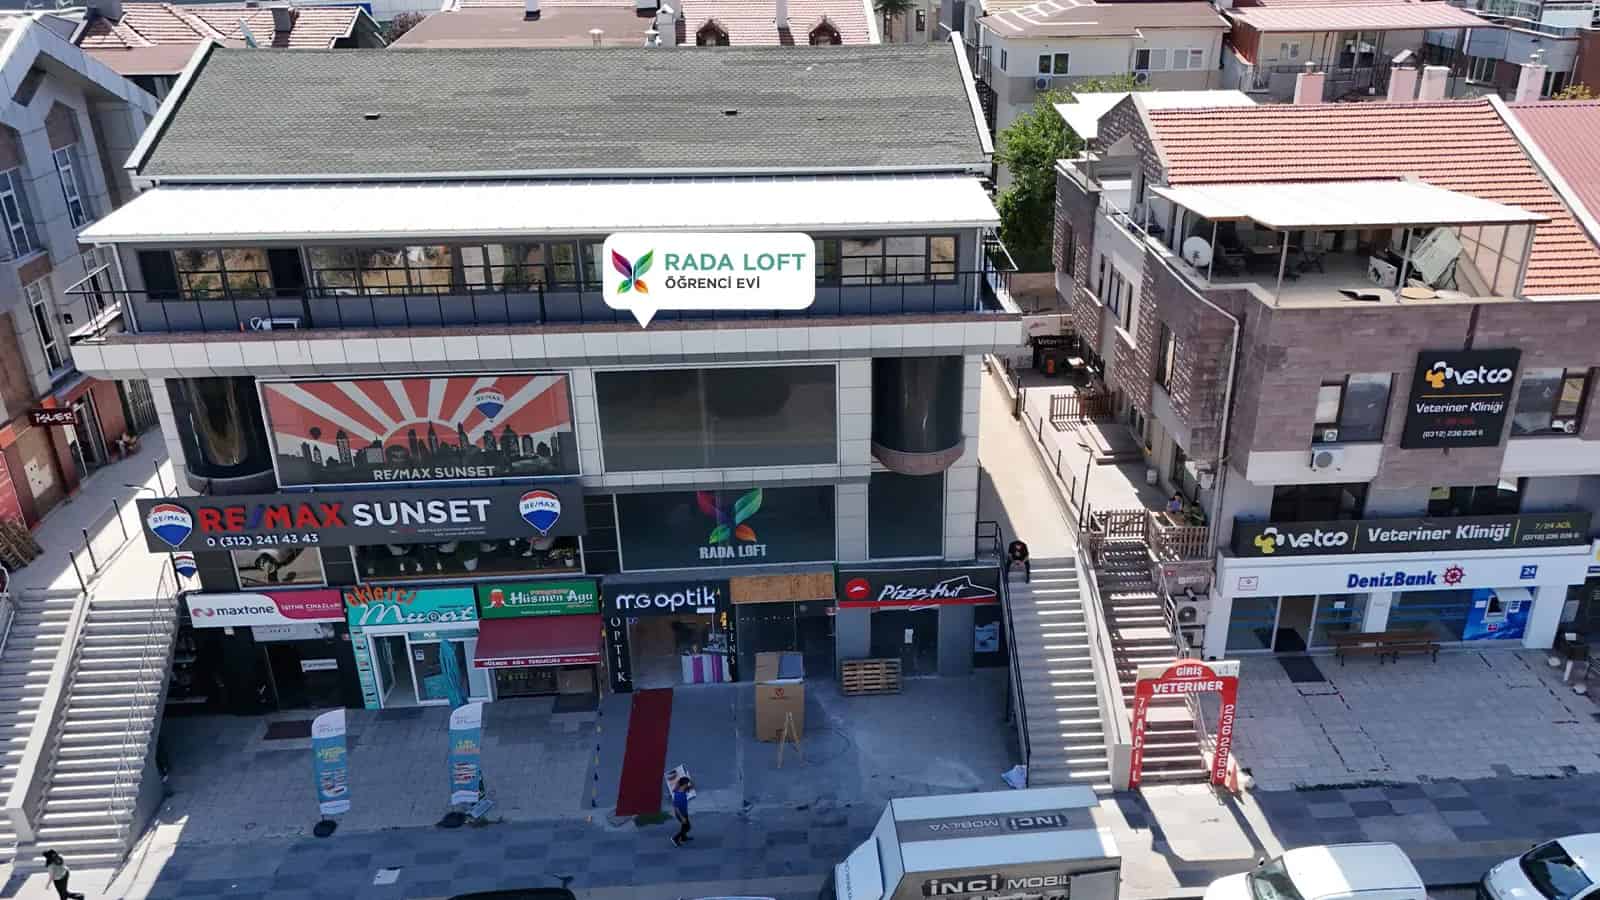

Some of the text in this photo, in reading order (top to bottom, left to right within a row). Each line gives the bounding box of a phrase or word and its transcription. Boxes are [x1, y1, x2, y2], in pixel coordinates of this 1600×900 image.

[1454, 365, 1513, 385] vetco
[1416, 401, 1504, 414] Veteriner Kliniği
[373, 466, 496, 481] RE/MAX SUNSET
[523, 500, 556, 510] RE/MAX
[152, 514, 187, 523] RE/MAX
[196, 499, 491, 535] RE/MAX SUNSET
[207, 533, 319, 547] 0 (312) 241 43 43
[1287, 528, 1349, 548] vetco
[1367, 523, 1512, 542] Veteriner Kliniği
[699, 544, 767, 559] RADA LOFT
[1522, 567, 1536, 576] 24
[1347, 570, 1439, 589] DenizBank
[654, 585, 716, 612] optik
[878, 583, 967, 602] Pizza Hut
[216, 604, 275, 617] maxtone
